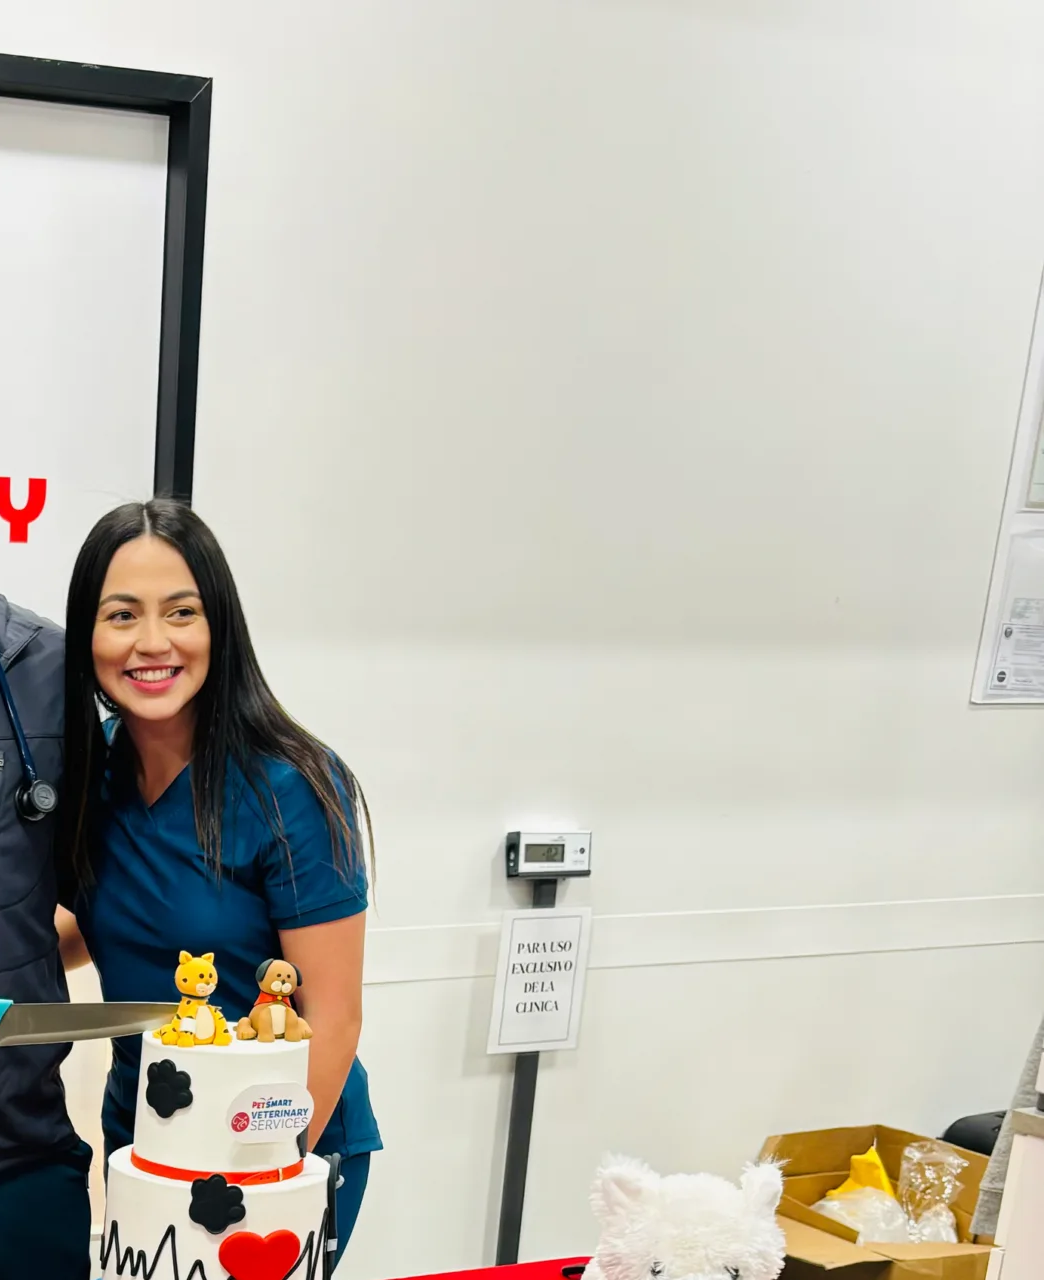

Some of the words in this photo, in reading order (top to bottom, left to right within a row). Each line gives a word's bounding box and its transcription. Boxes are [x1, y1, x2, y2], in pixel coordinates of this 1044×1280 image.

[517, 942, 547, 954] PARA
[550, 940, 573, 953] USO
[511, 960, 574, 975] EXCLUSIVO
[524, 981, 539, 994] DE
[540, 981, 555, 993] LA
[515, 1000, 559, 1014] CLINICA
[252, 1099, 293, 1110] PETSMART
[251, 1108, 309, 1120] VETERINARY
[250, 1117, 309, 1131] SERVICES
